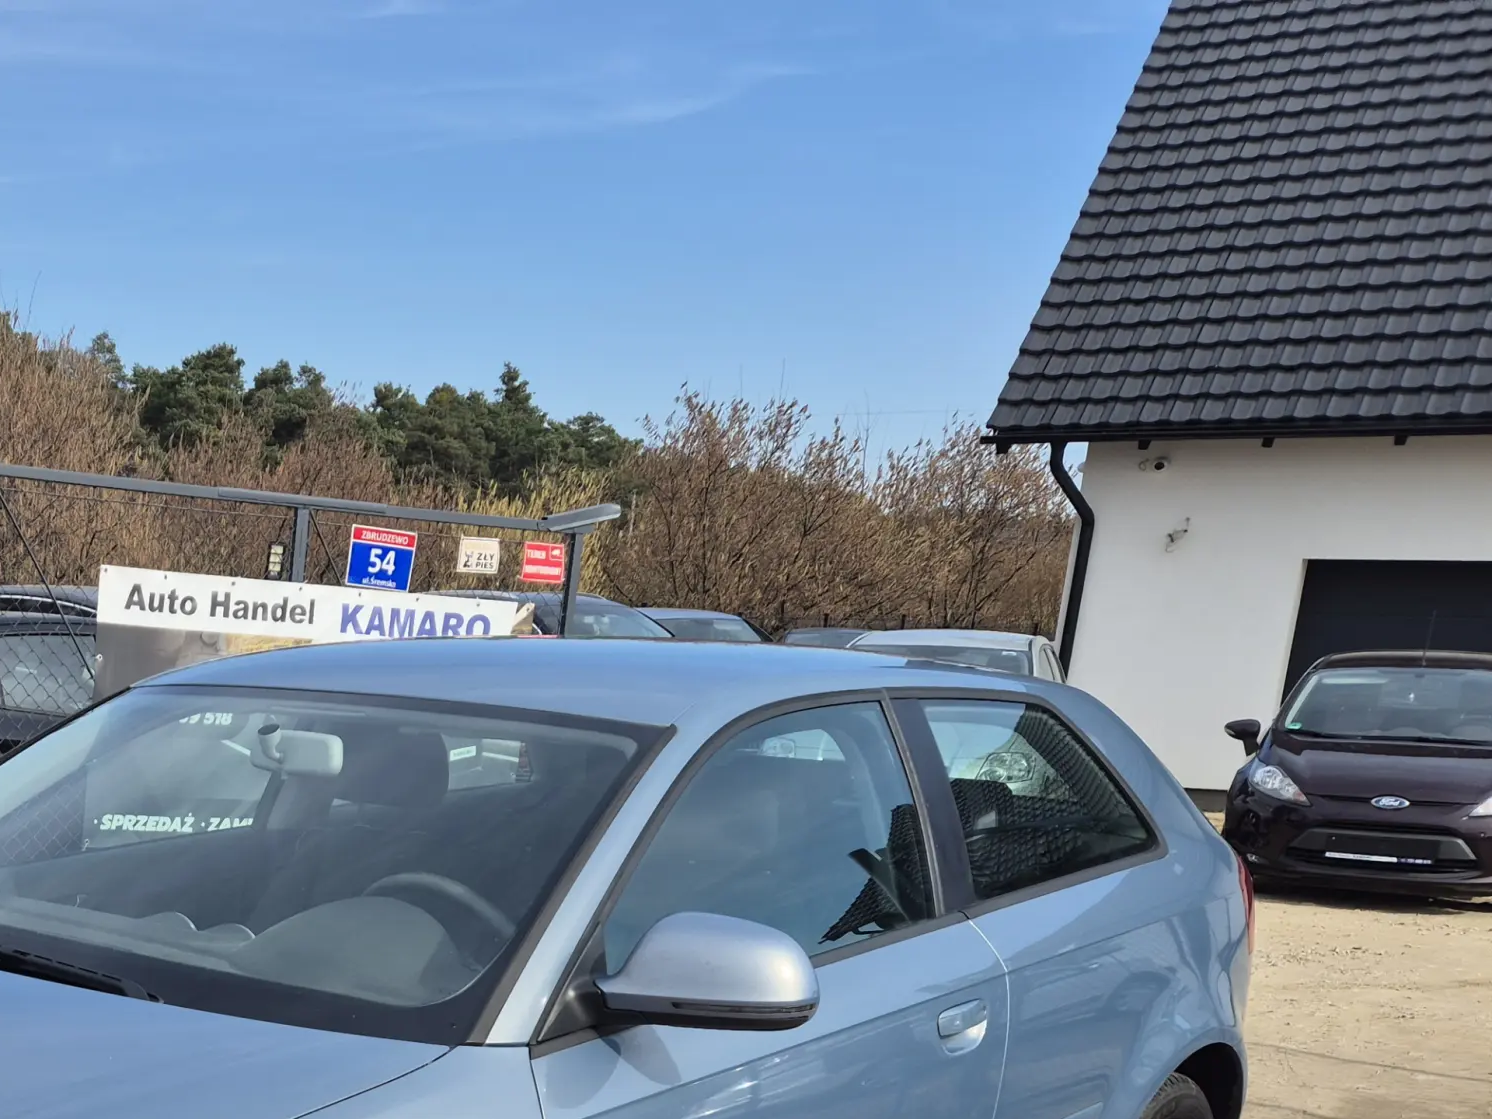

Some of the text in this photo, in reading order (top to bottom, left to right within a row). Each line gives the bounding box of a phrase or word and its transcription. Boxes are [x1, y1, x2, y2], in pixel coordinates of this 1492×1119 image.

[361, 530, 409, 545] ZBRUDZEWO
[367, 548, 396, 576] 54
[475, 561, 494, 569] PIES
[477, 552, 495, 561] ZŁY
[124, 583, 491, 640] Auto Handel KAMARO
[99, 812, 196, 833] SPRZEDAŻ
